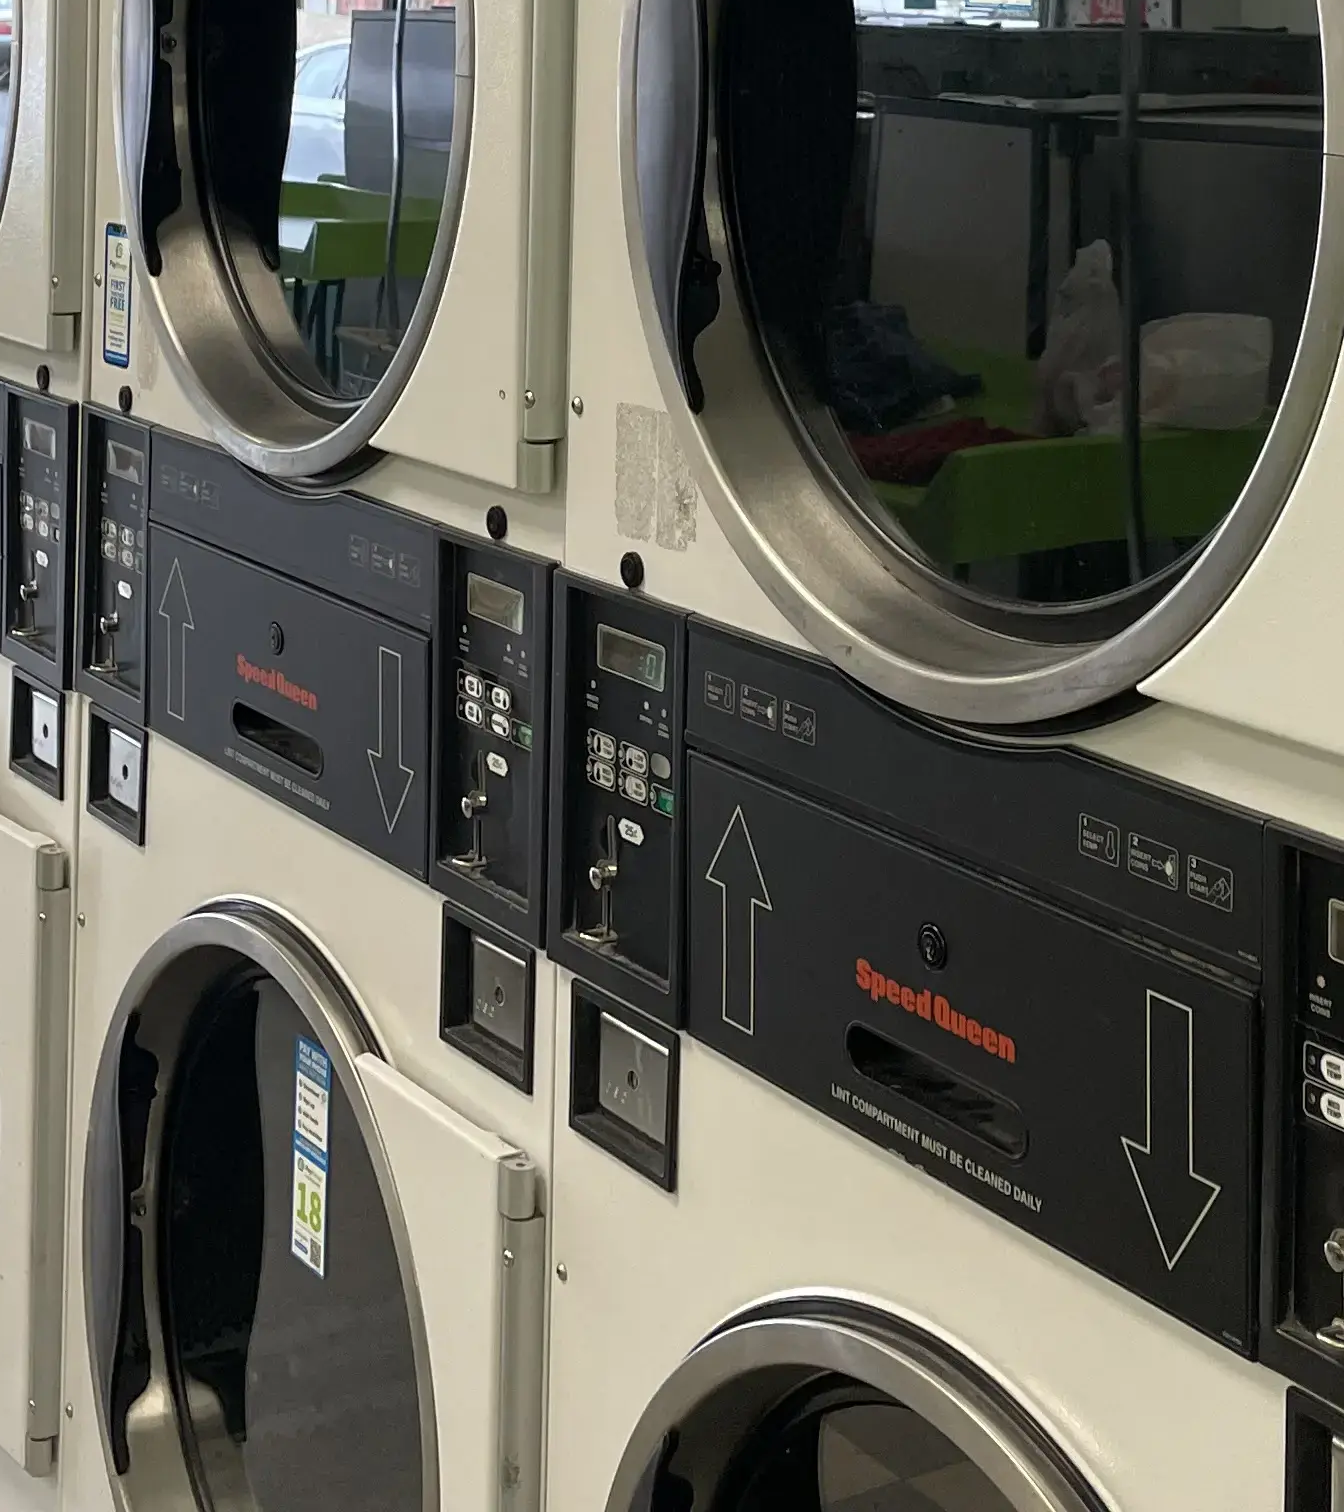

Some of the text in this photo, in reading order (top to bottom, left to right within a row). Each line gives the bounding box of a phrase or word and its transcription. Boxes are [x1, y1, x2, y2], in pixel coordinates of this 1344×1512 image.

[236, 653, 318, 710] Speed Queen
[856, 957, 1016, 1064] Speed Queen
[831, 1083, 1042, 1213] LINT COMPARTMENT MUST BE CLEANED DAILY
[297, 1182, 322, 1233] 18
